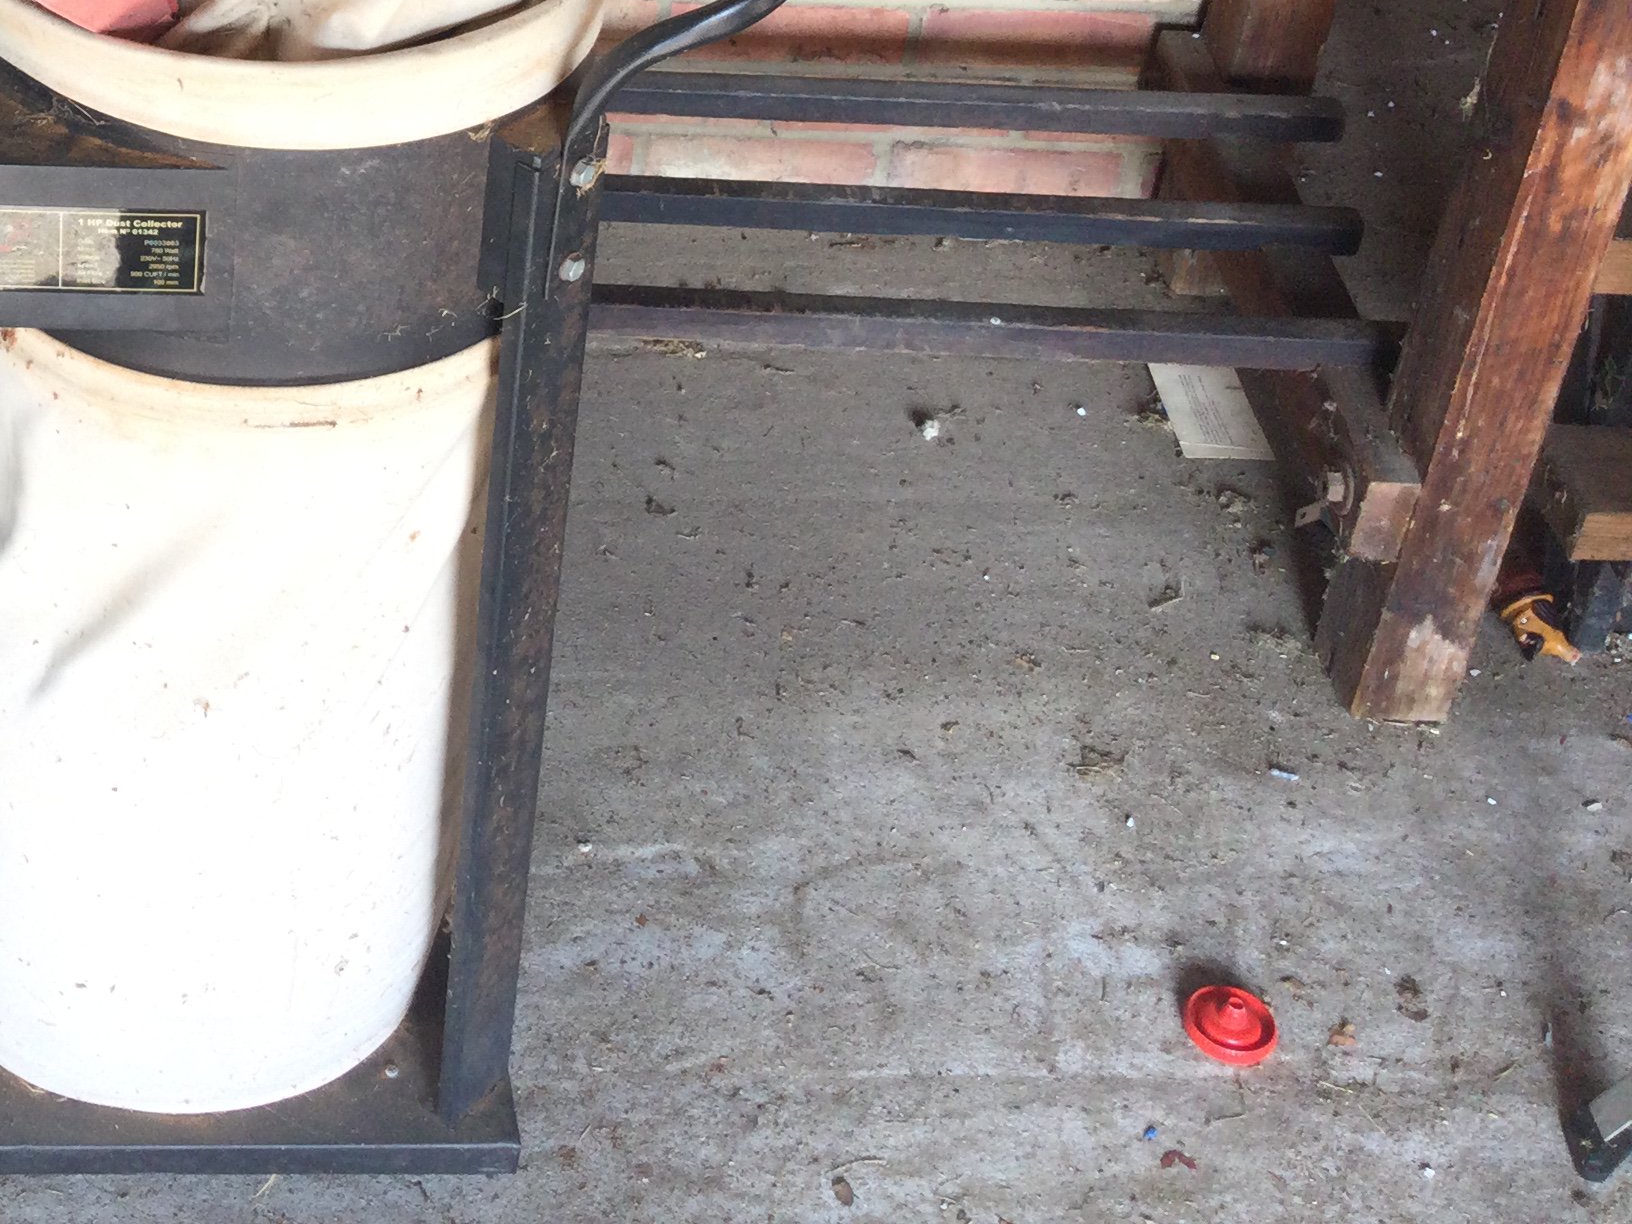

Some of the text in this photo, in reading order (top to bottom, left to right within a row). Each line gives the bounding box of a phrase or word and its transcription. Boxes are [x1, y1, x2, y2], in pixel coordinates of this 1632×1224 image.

[78, 218, 183, 229] 1 HP Dust Collector
